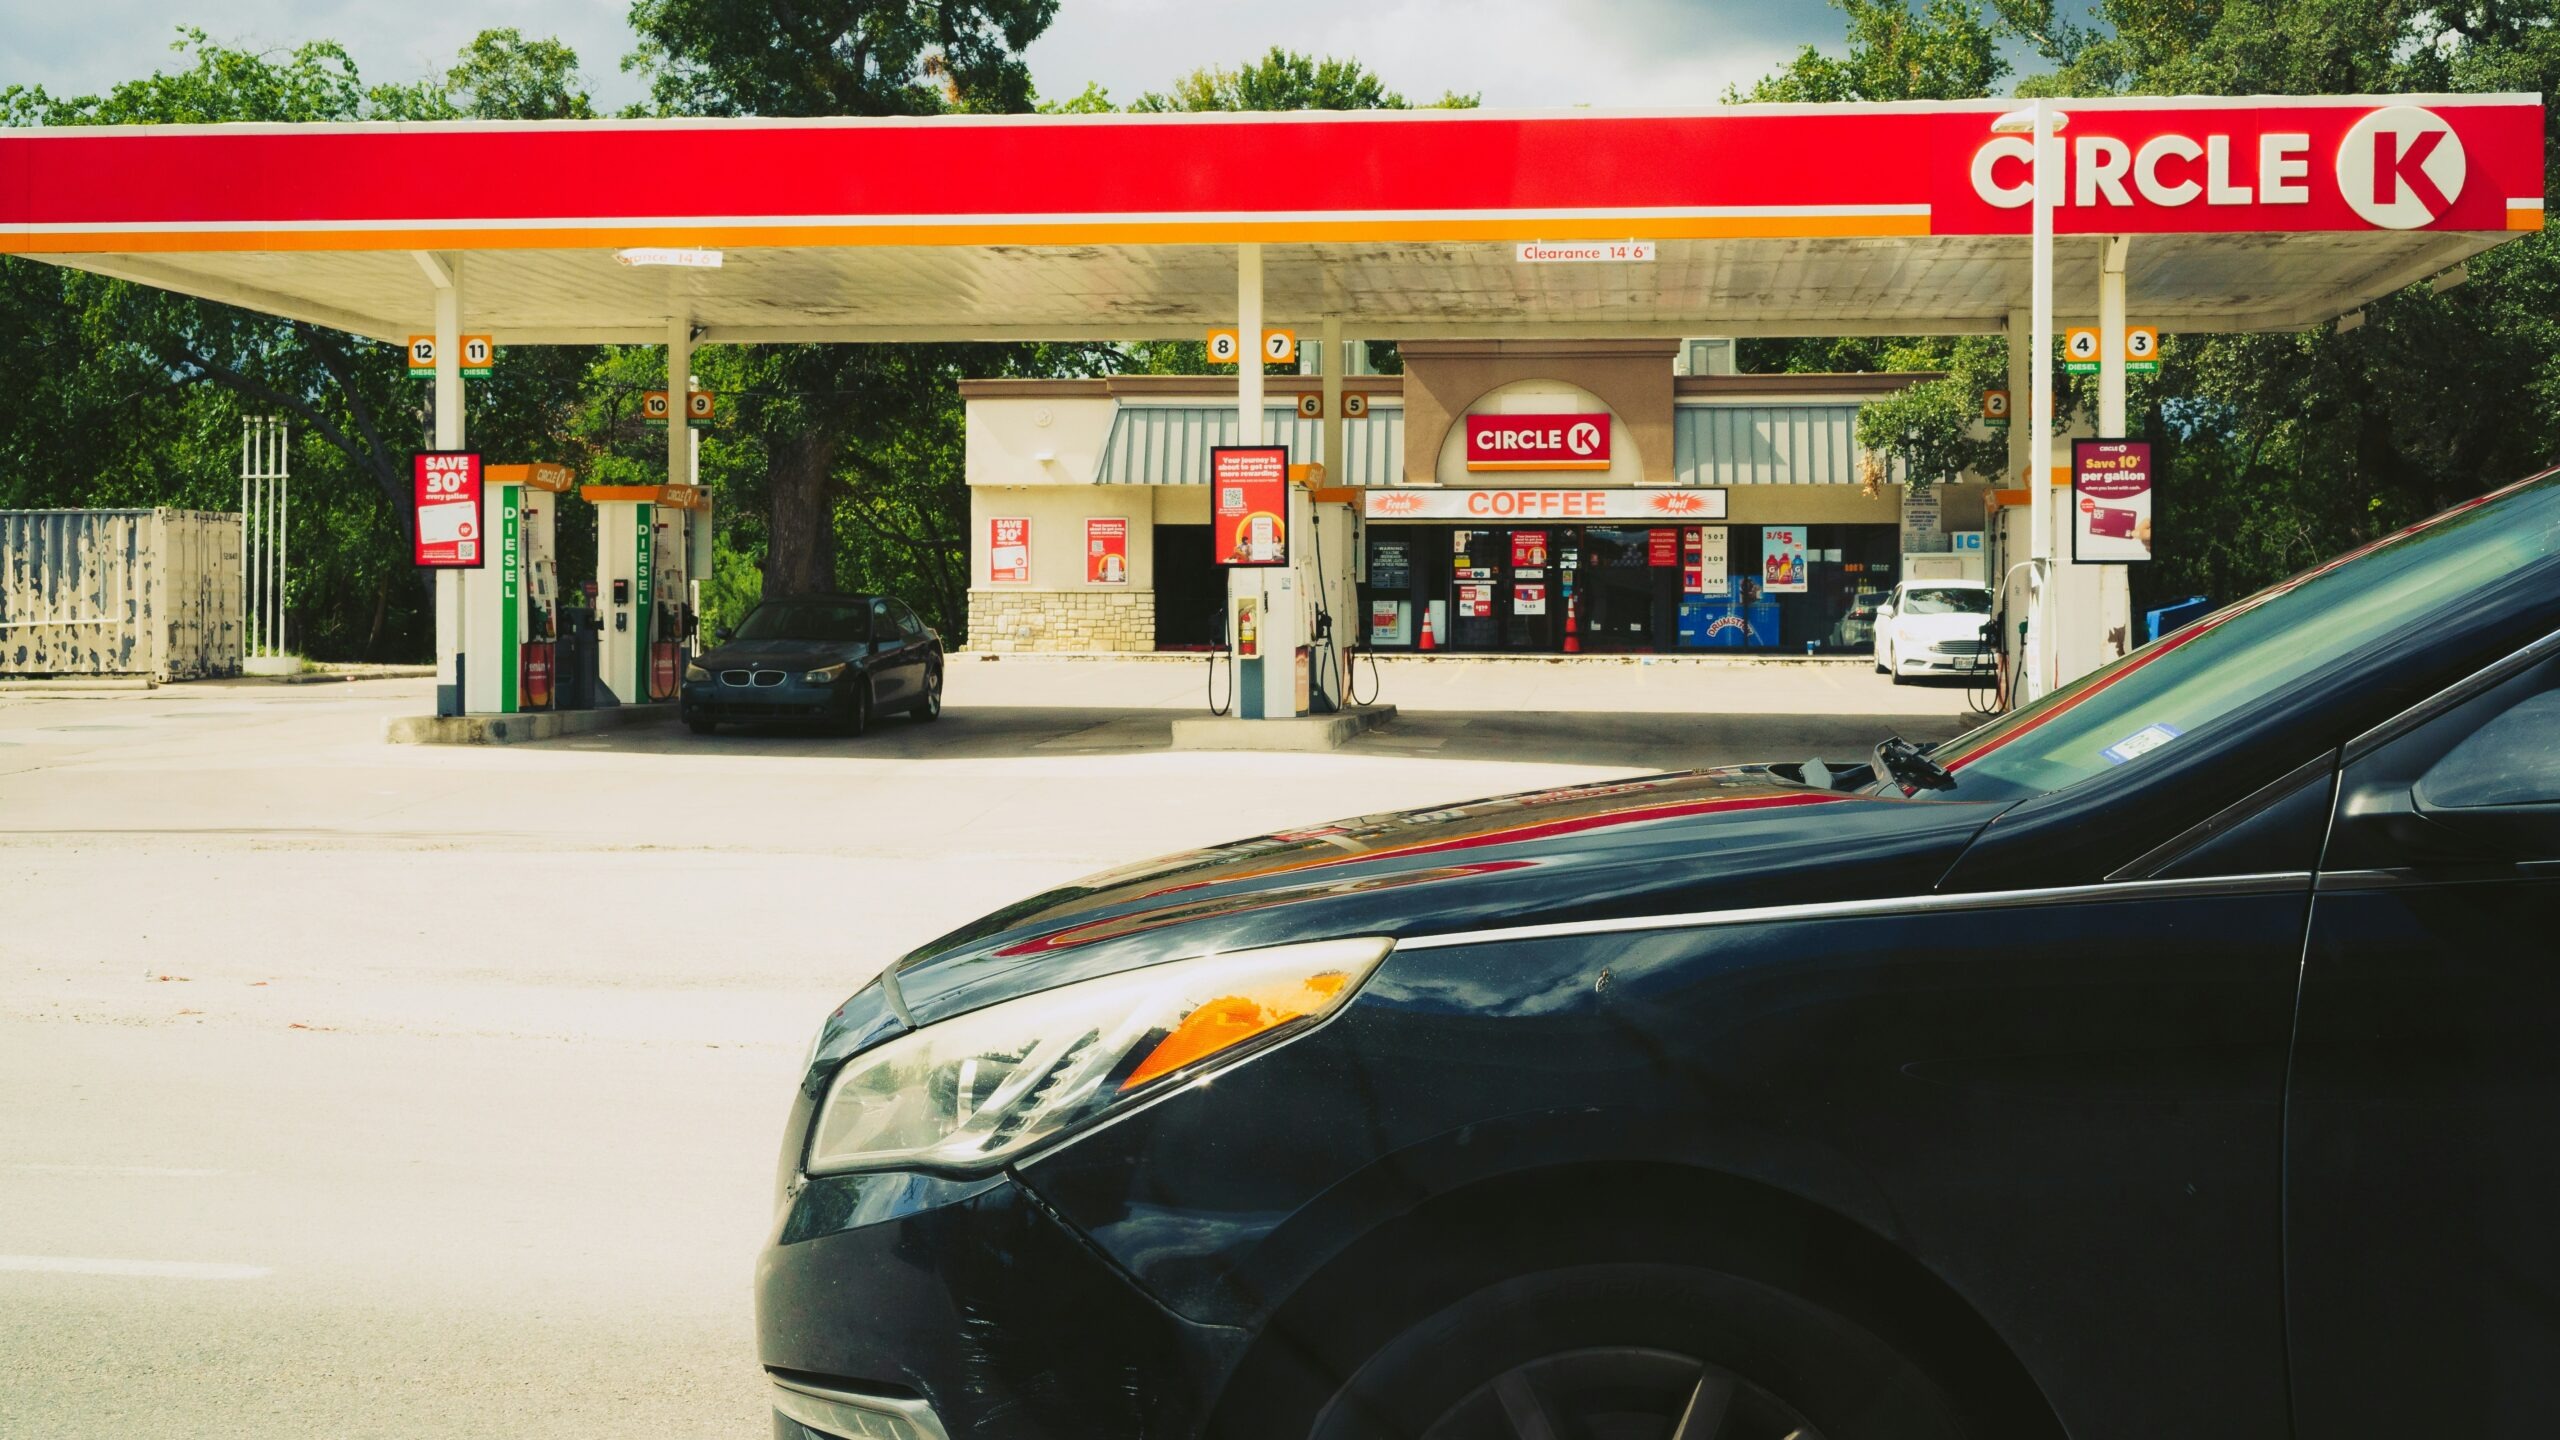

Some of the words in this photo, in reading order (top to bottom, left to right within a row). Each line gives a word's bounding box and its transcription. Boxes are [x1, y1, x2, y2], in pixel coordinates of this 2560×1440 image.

[1971, 132, 2309, 208] CIRCLE
[2372, 130, 2453, 220] K
[1524, 246, 1601, 259] Clearance
[1217, 339, 1229, 354] 8
[1272, 339, 1284, 354] 7
[2076, 337, 2090, 352] 4
[2134, 336, 2147, 351] 3
[414, 344, 433, 359] 12
[468, 344, 485, 359] 11
[410, 368, 437, 376] DIESEL
[463, 368, 490, 376] DIESEL
[2067, 363, 2098, 371] DIESEL
[2126, 362, 2155, 370] DIESEL
[649, 399, 667, 412] 10
[696, 398, 706, 411] 9
[1304, 399, 1316, 412] 6
[1349, 399, 1360, 412] 5
[1992, 398, 2002, 410] 2
[1476, 430, 1562, 450] CIRCLE
[1576, 428, 1598, 450] K
[425, 456, 469, 471] SAVE
[1217, 463, 1240, 471] about
[1222, 456, 1240, 464] Your
[1240, 456, 1269, 465] journey
[2085, 458, 2116, 469] Save
[2118, 455, 2141, 469] 10¢
[426, 470, 468, 493] 30¢
[536, 468, 557, 484] CIRCLE
[2081, 472, 2103, 484] per
[2103, 470, 2146, 484] gallon
[425, 493, 445, 501] every
[1385, 498, 1411, 510] Fresh
[1467, 491, 1606, 516] COFFEE
[1667, 498, 1689, 510] Hot!
[996, 519, 1022, 529] SAVE
[1766, 531, 1793, 545] 3/$5
[1956, 534, 1980, 549] IC
[503, 506, 516, 598] DIESEL
[638, 524, 649, 605] DIESEL
